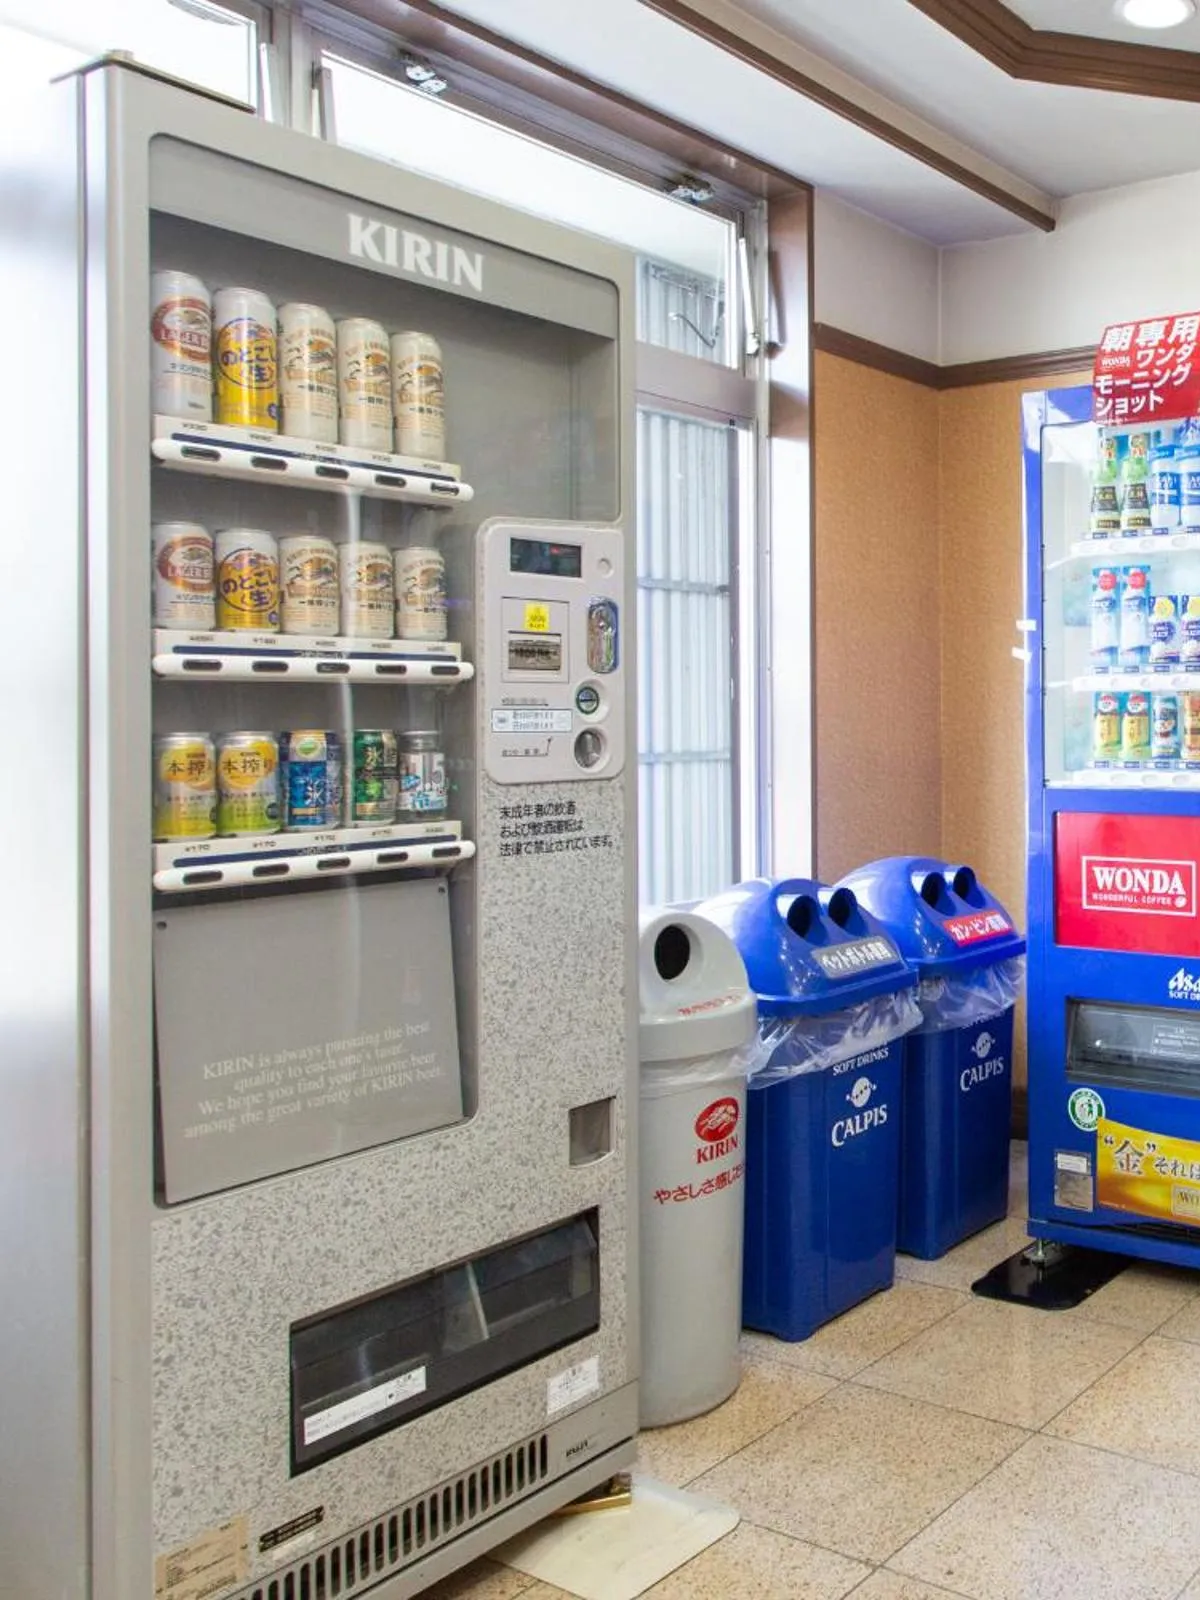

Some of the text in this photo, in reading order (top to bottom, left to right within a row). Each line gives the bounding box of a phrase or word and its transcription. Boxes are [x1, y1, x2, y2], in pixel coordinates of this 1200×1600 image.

[347, 213, 484, 292] KIRIN
[1136, 341, 1198, 368] ワンダ
[1095, 363, 1193, 395] モーニング
[1096, 390, 1165, 417] ショット
[1092, 866, 1186, 895] WONDA
[1092, 892, 1172, 906] WONDERFUL COFFEE
[1169, 990, 1188, 1001] SOFT
[203, 1056, 255, 1081] KIRIN
[259, 1053, 272, 1068] is
[274, 1045, 322, 1066] always
[383, 1026, 402, 1042] the
[833, 1047, 890, 1077] SOFT DRINKS
[288, 1065, 301, 1078] to
[371, 1072, 414, 1094] KIRIN
[960, 1056, 1005, 1092] CALPIS
[198, 1098, 225, 1116] We
[227, 1090, 265, 1112] hope
[267, 1085, 294, 1103] you
[297, 1075, 325, 1092] find
[328, 1070, 359, 1092] your
[831, 1103, 888, 1148] CALPIS
[696, 1135, 739, 1165] KIRIN
